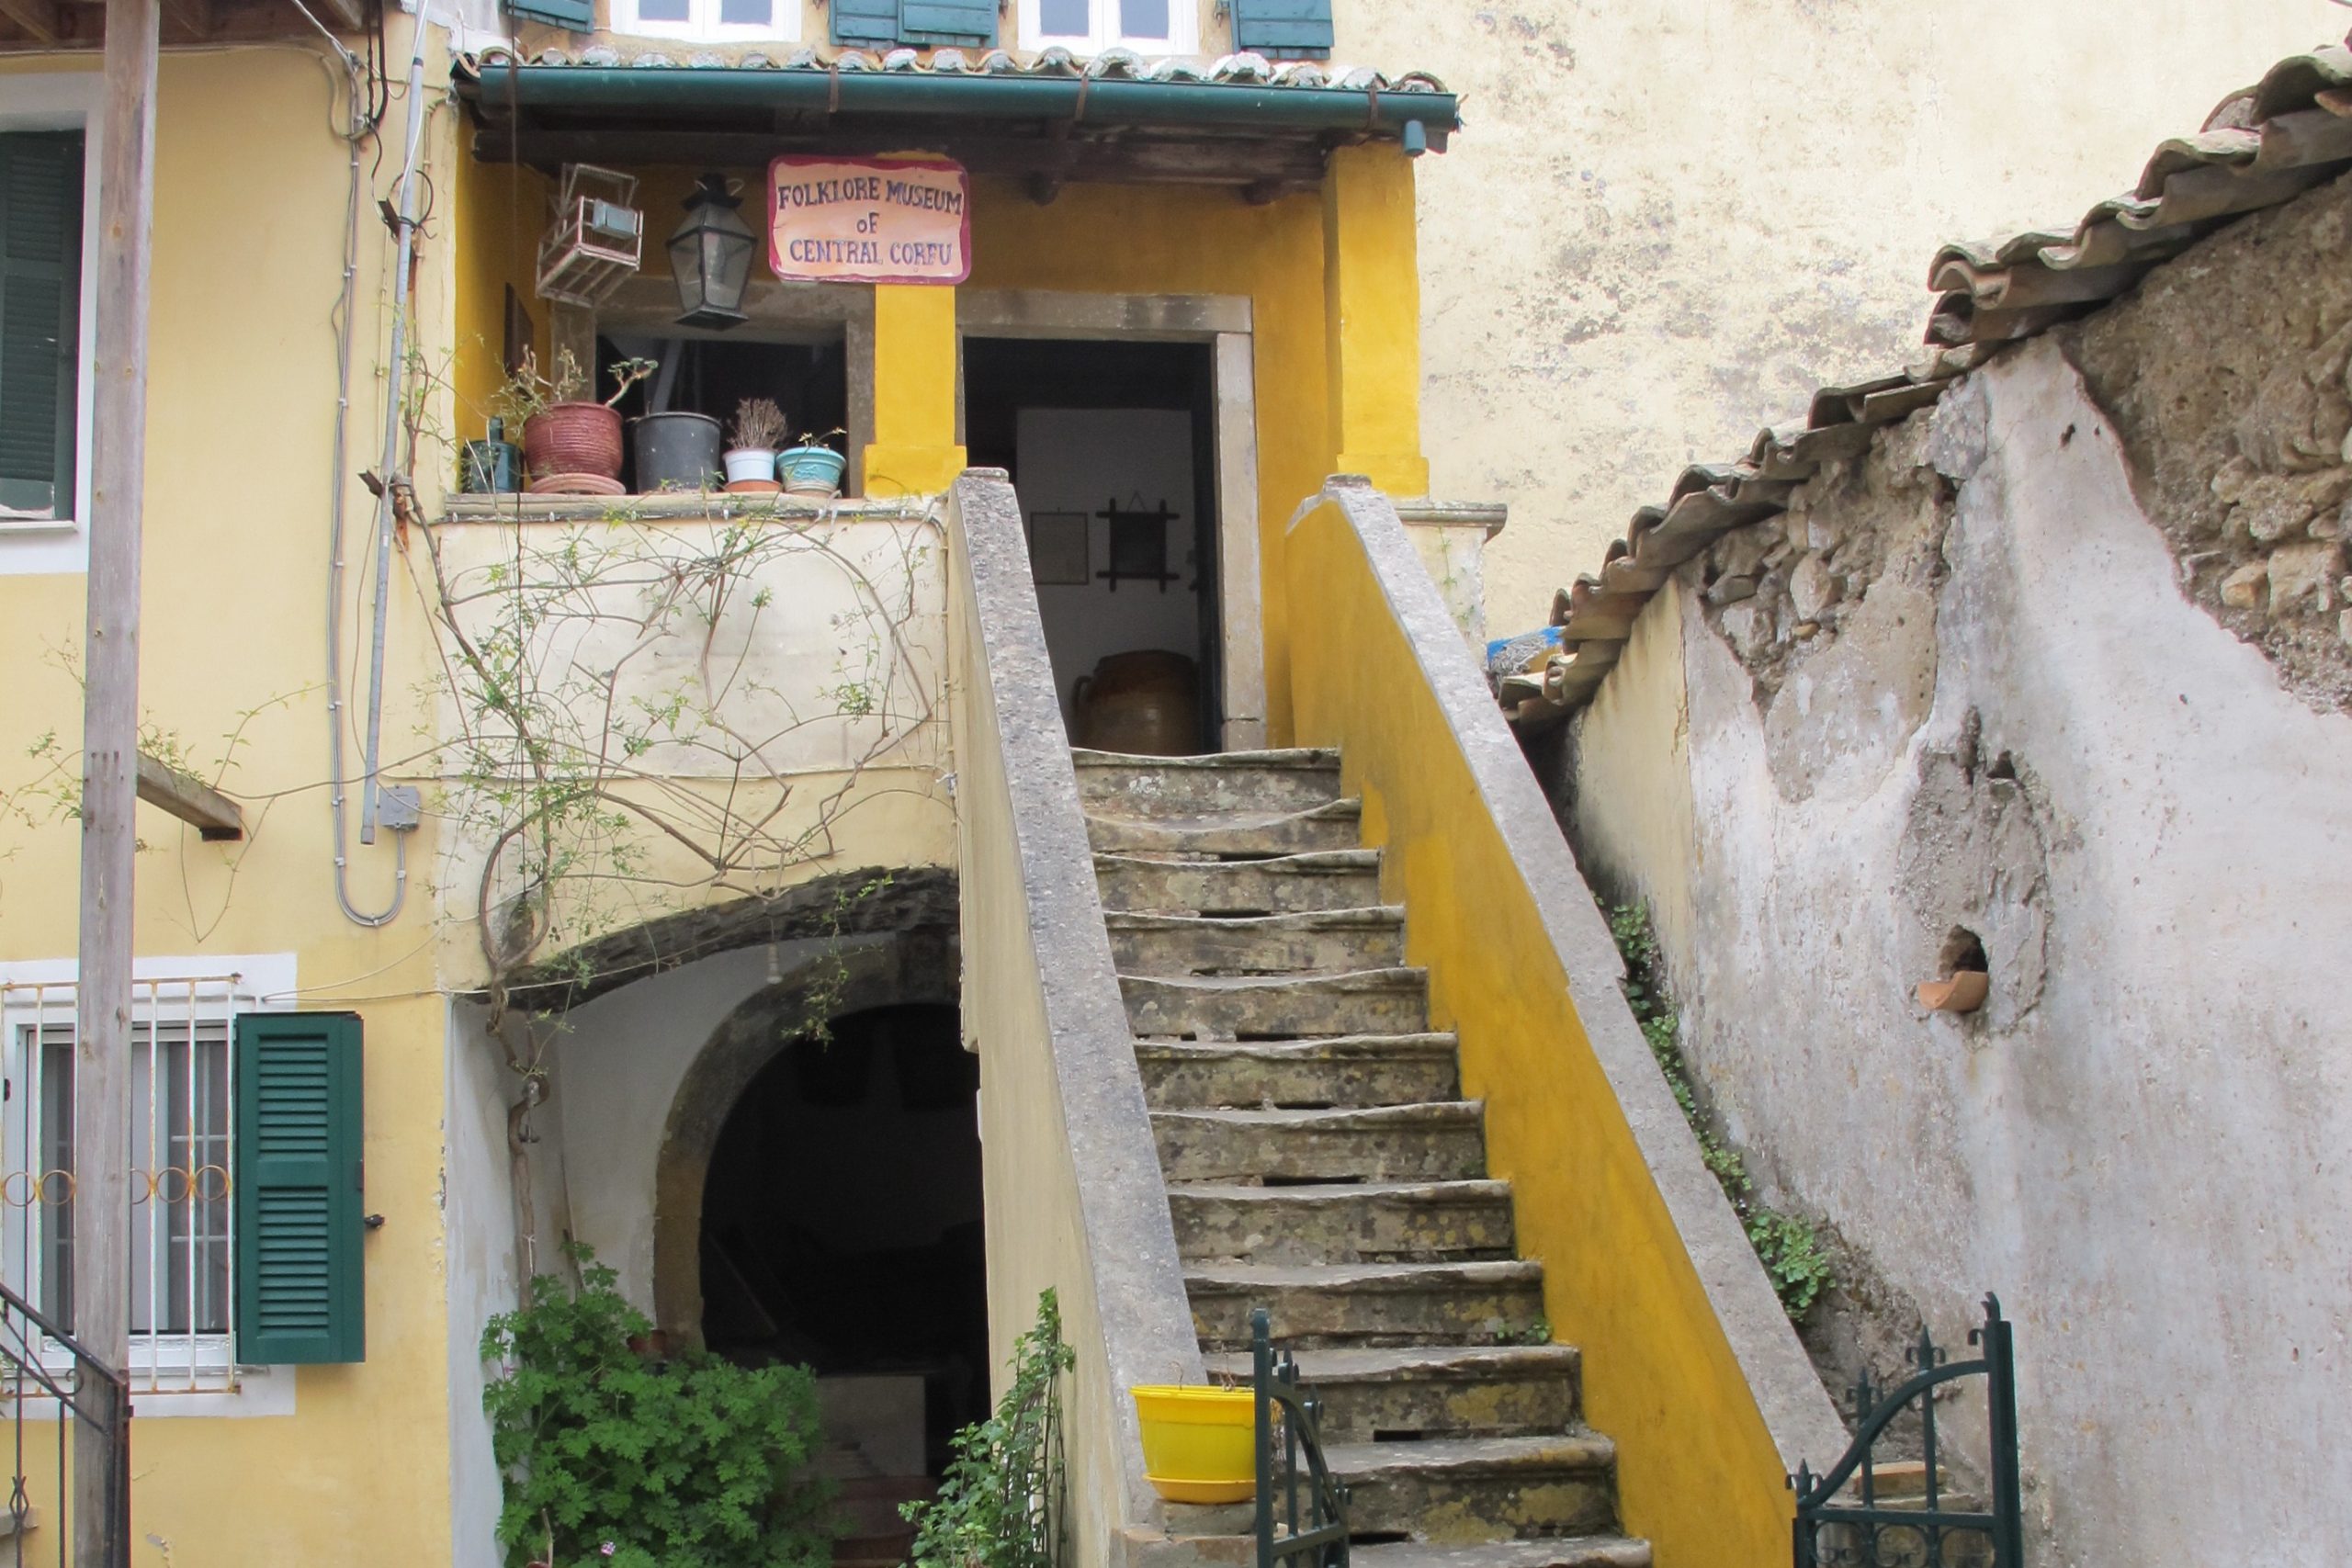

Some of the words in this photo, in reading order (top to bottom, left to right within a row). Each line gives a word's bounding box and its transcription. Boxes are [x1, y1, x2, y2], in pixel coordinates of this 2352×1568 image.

[777, 176, 881, 209] FOLKLORE
[886, 179, 963, 216] MUSEUM
[789, 239, 884, 265] CENTRAL
[889, 242, 953, 266] CORFU
